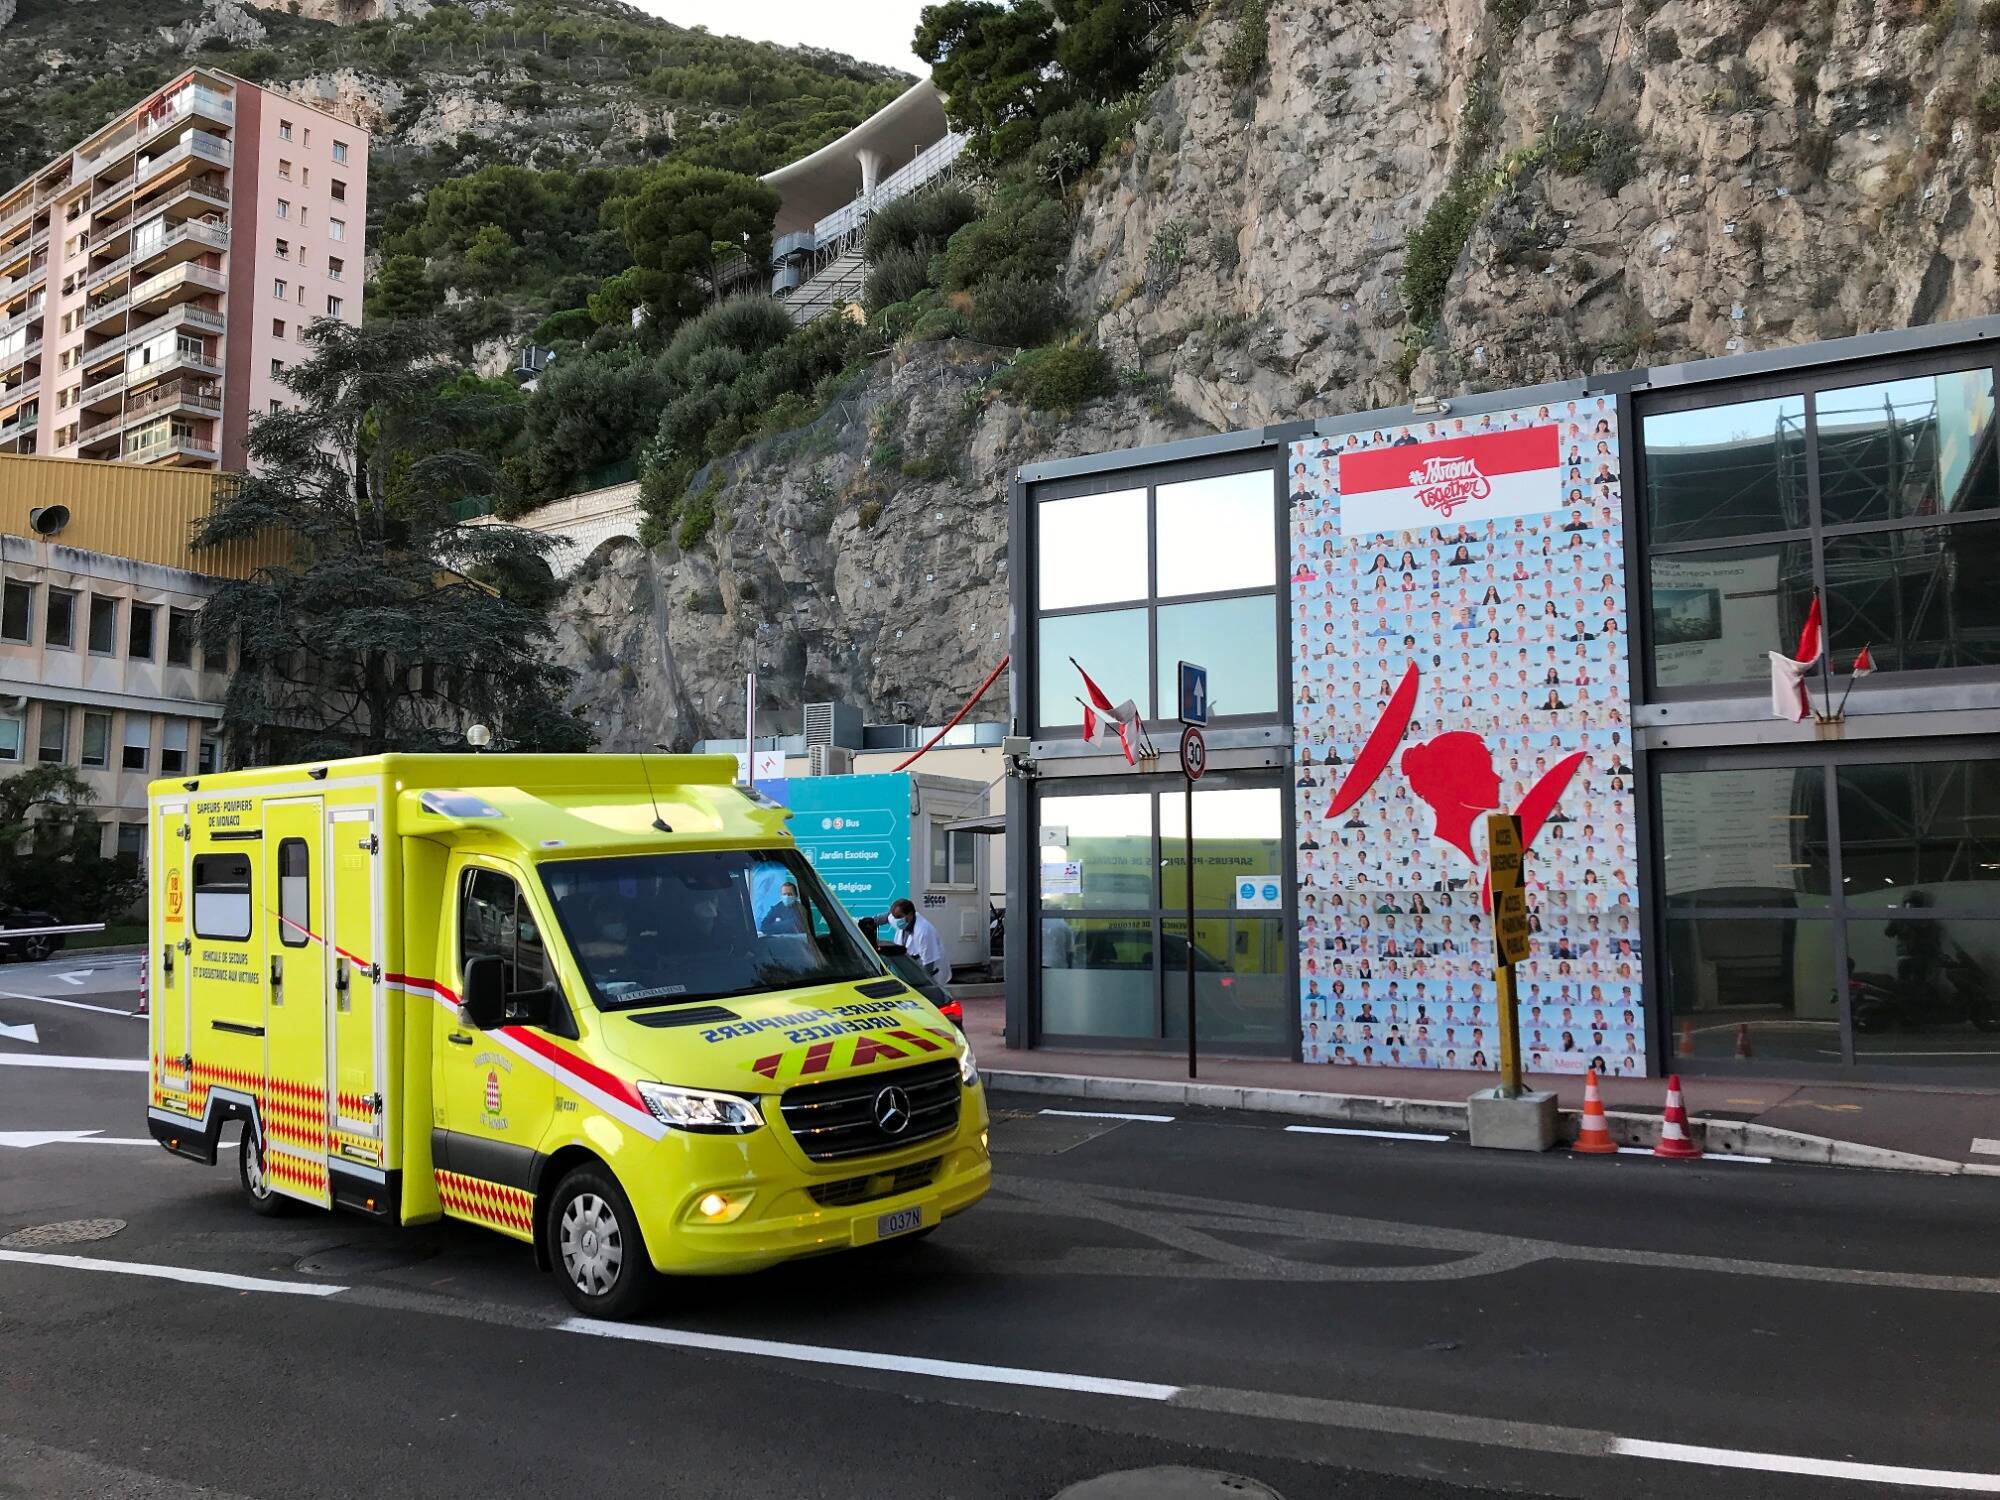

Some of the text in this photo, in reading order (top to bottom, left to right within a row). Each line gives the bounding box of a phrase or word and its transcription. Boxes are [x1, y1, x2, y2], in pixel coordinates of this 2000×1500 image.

[1188, 741, 1201, 766] 30
[208, 815, 240, 827] DE MONACO
[845, 819, 860, 828] Bus
[819, 850, 879, 862] Jardin Exotique
[837, 882, 872, 893] Belgique
[222, 951, 228, 963] DE
[228, 952, 248, 965] SECOURS
[193, 967, 198, 977] ET
[228, 970, 237, 982] AUX
[238, 971, 259, 984] VICTIMES
[632, 985, 684, 998] CONDAMINE
[889, 1206, 920, 1232] 037N
